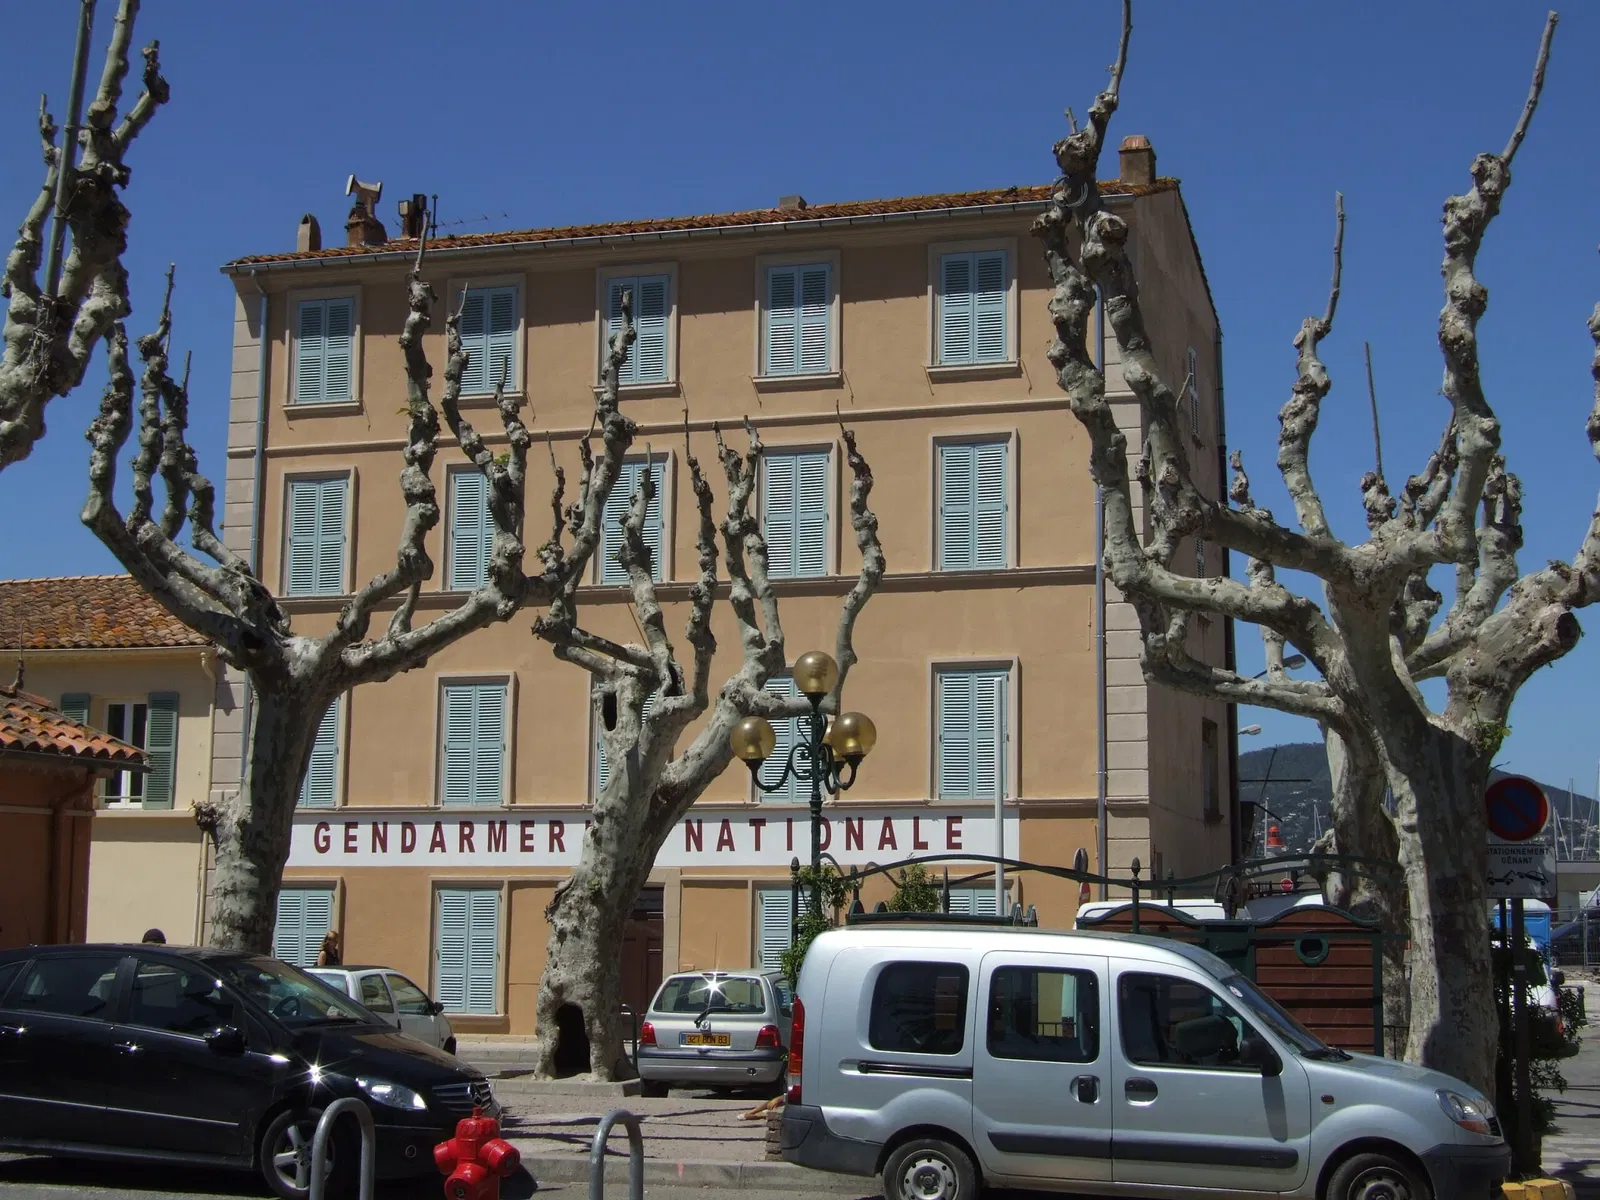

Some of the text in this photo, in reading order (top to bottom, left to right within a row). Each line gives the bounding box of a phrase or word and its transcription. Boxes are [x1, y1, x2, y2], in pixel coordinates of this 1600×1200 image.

[314, 815, 963, 854] GENDARMER NATIONALE
[1484, 847, 1549, 855] STATIONNEMENT
[1501, 855, 1533, 864] GÊNANT
[687, 1035, 700, 1044] 327
[718, 1035, 728, 1044] 83
